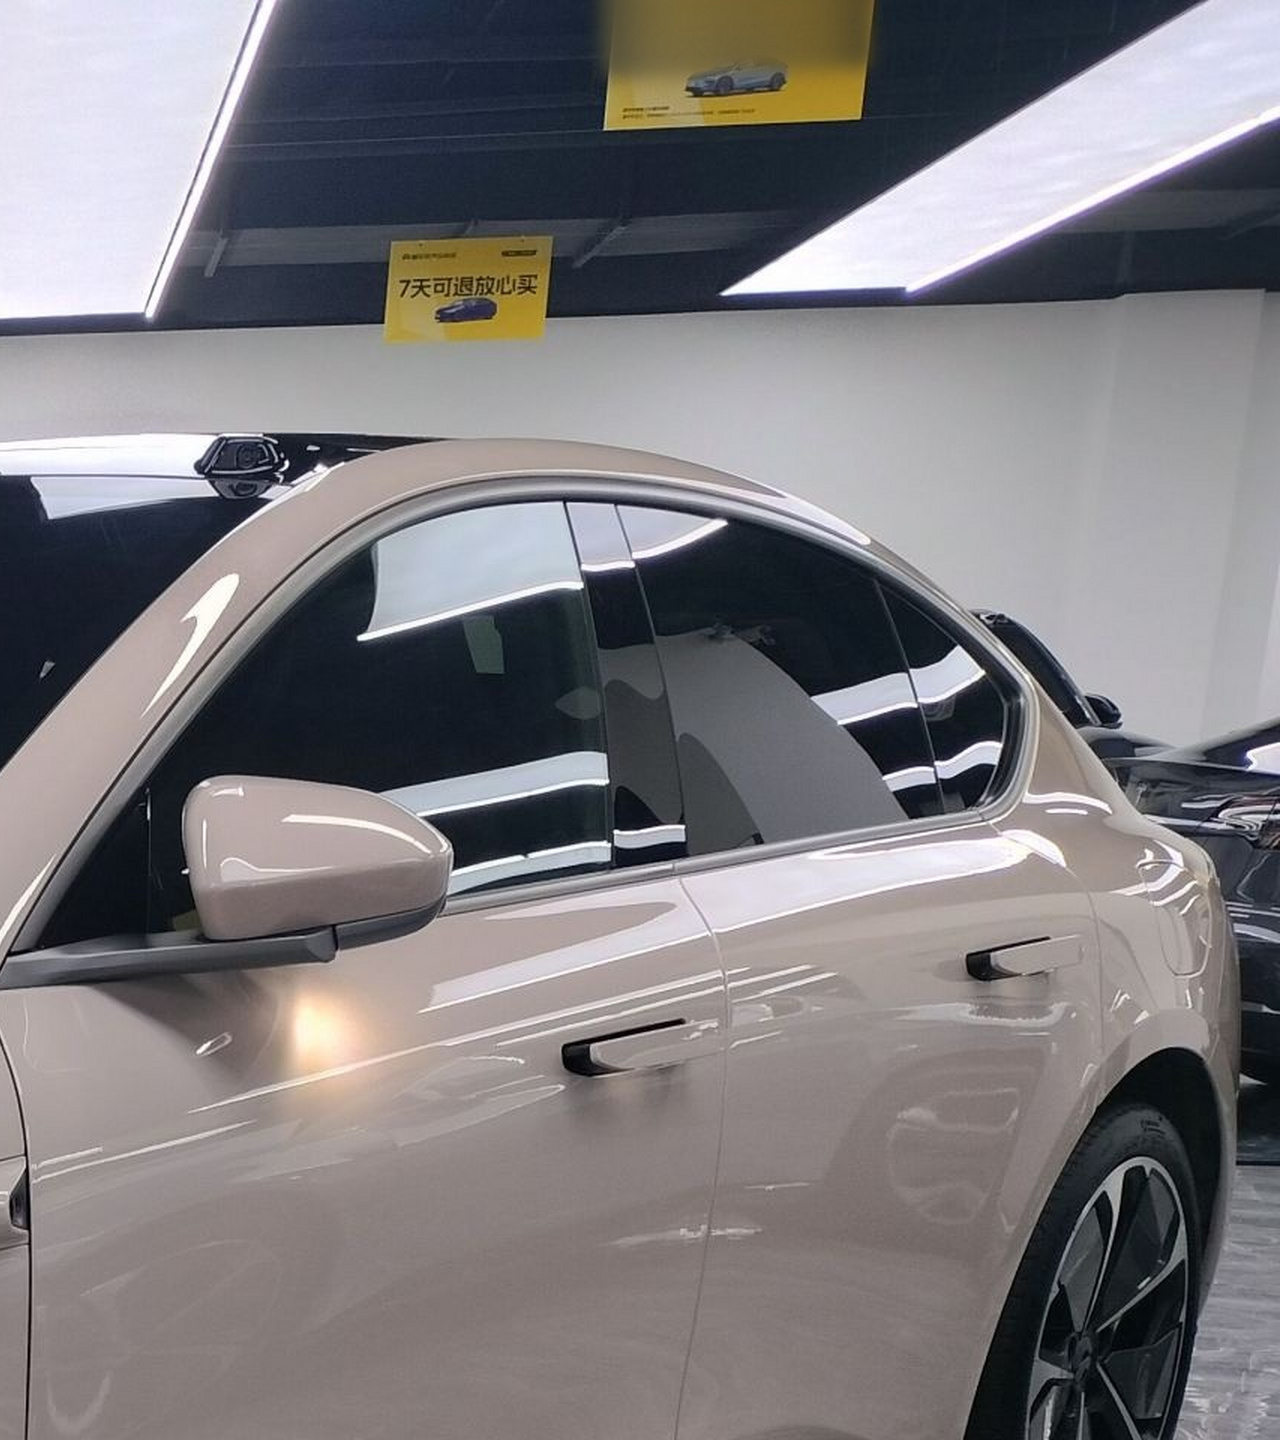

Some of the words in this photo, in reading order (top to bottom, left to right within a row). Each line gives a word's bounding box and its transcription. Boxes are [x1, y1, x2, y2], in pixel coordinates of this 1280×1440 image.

[398, 273, 539, 299] 7天可退放心买
